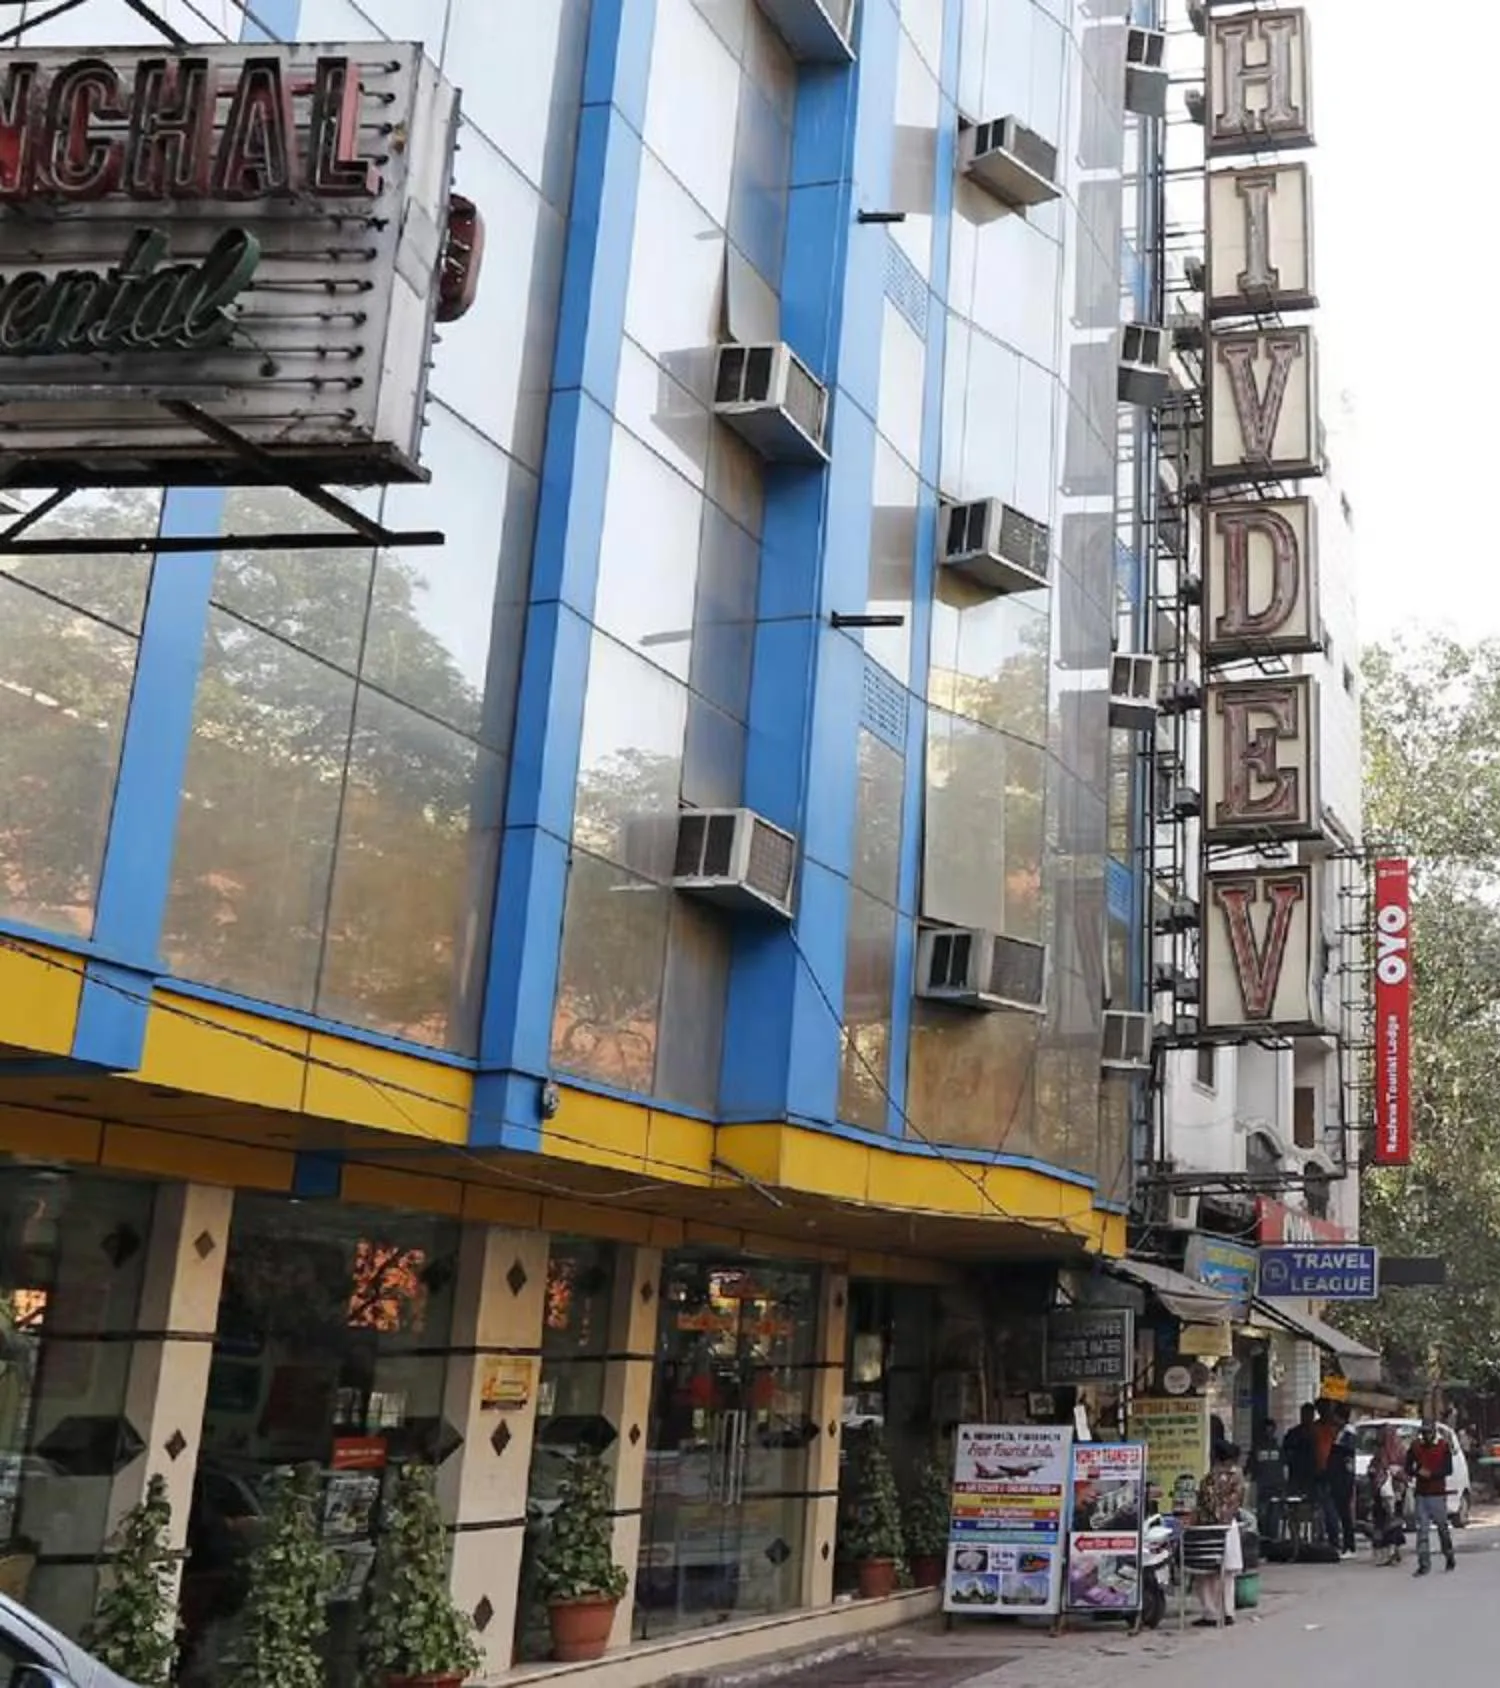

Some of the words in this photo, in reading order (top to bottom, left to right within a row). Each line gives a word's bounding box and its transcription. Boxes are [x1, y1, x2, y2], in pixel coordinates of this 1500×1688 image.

[1377, 904, 1407, 985] OYO
[1292, 1252, 1370, 1269] TRAVEL
[1291, 1276, 1371, 1292] LEAGUE
